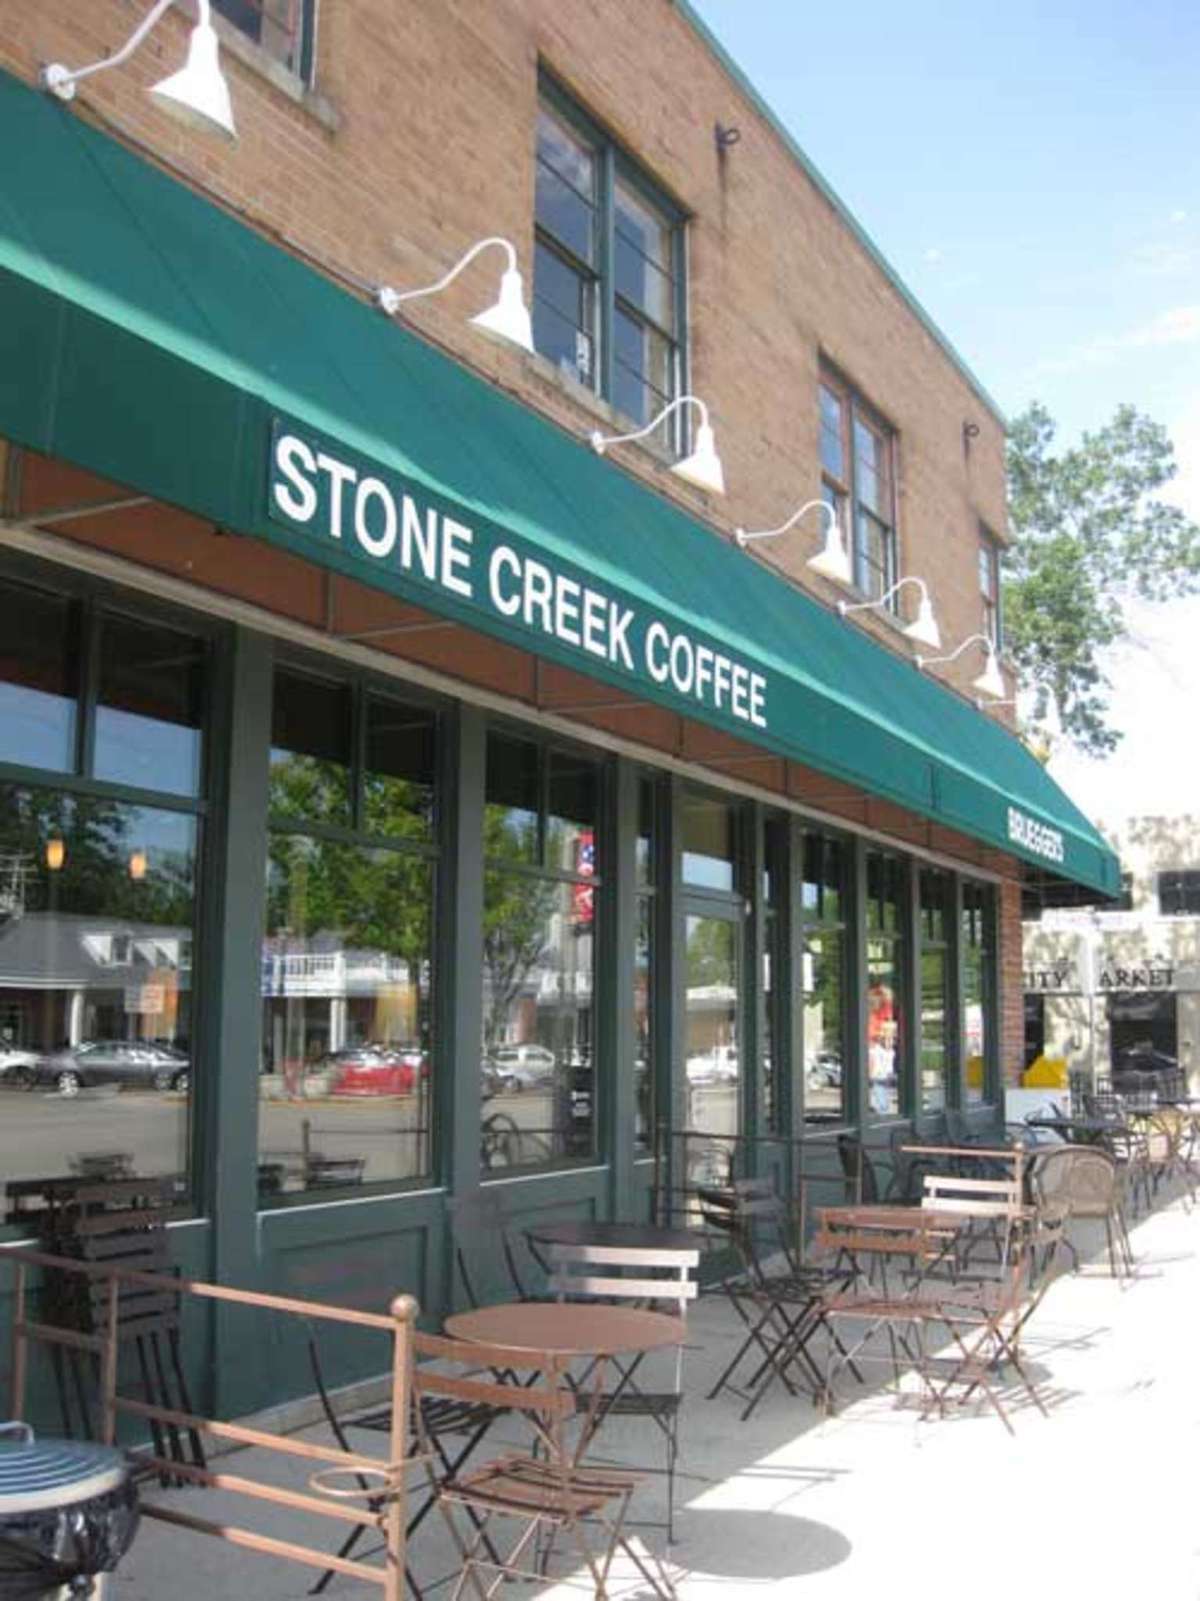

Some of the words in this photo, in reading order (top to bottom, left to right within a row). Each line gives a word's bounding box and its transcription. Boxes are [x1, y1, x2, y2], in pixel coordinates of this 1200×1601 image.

[274, 435, 474, 598] STONE
[488, 545, 634, 671] CREEK
[644, 622, 767, 728] COFFEE
[1023, 970, 1068, 988] ITY
[1099, 968, 1174, 987] ARKET
